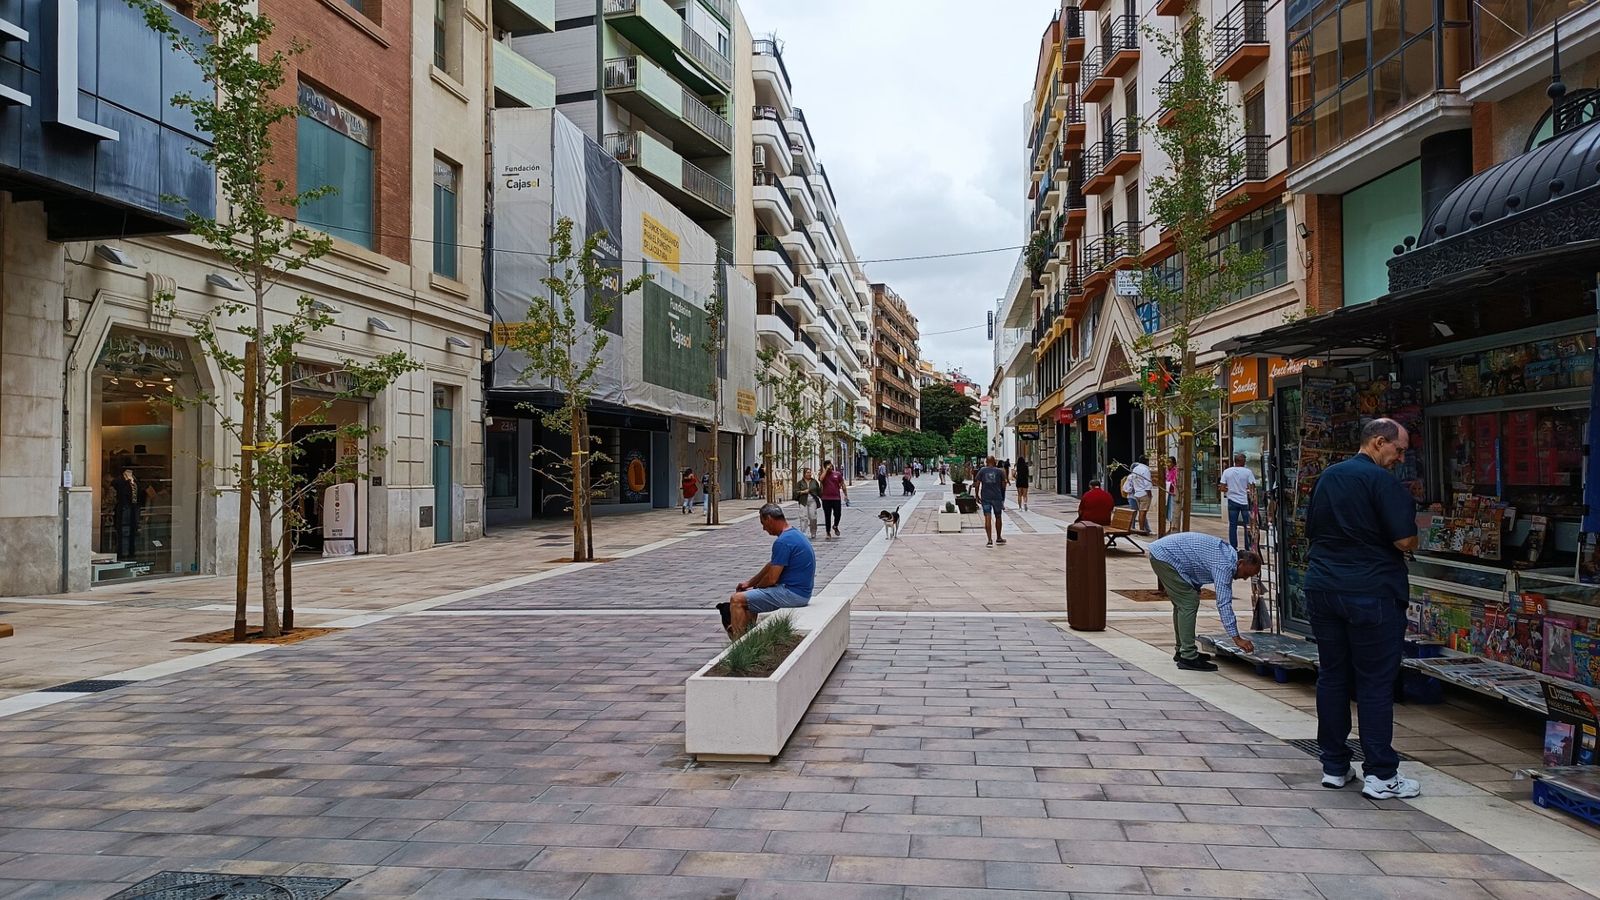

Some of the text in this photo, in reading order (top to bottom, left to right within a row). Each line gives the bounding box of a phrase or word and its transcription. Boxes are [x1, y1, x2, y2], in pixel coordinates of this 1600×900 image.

[505, 164, 540, 172] Fundación
[506, 177, 540, 191] Cajasol
[670, 324, 692, 349] Cajasol
[150, 343, 184, 361] ROMA
